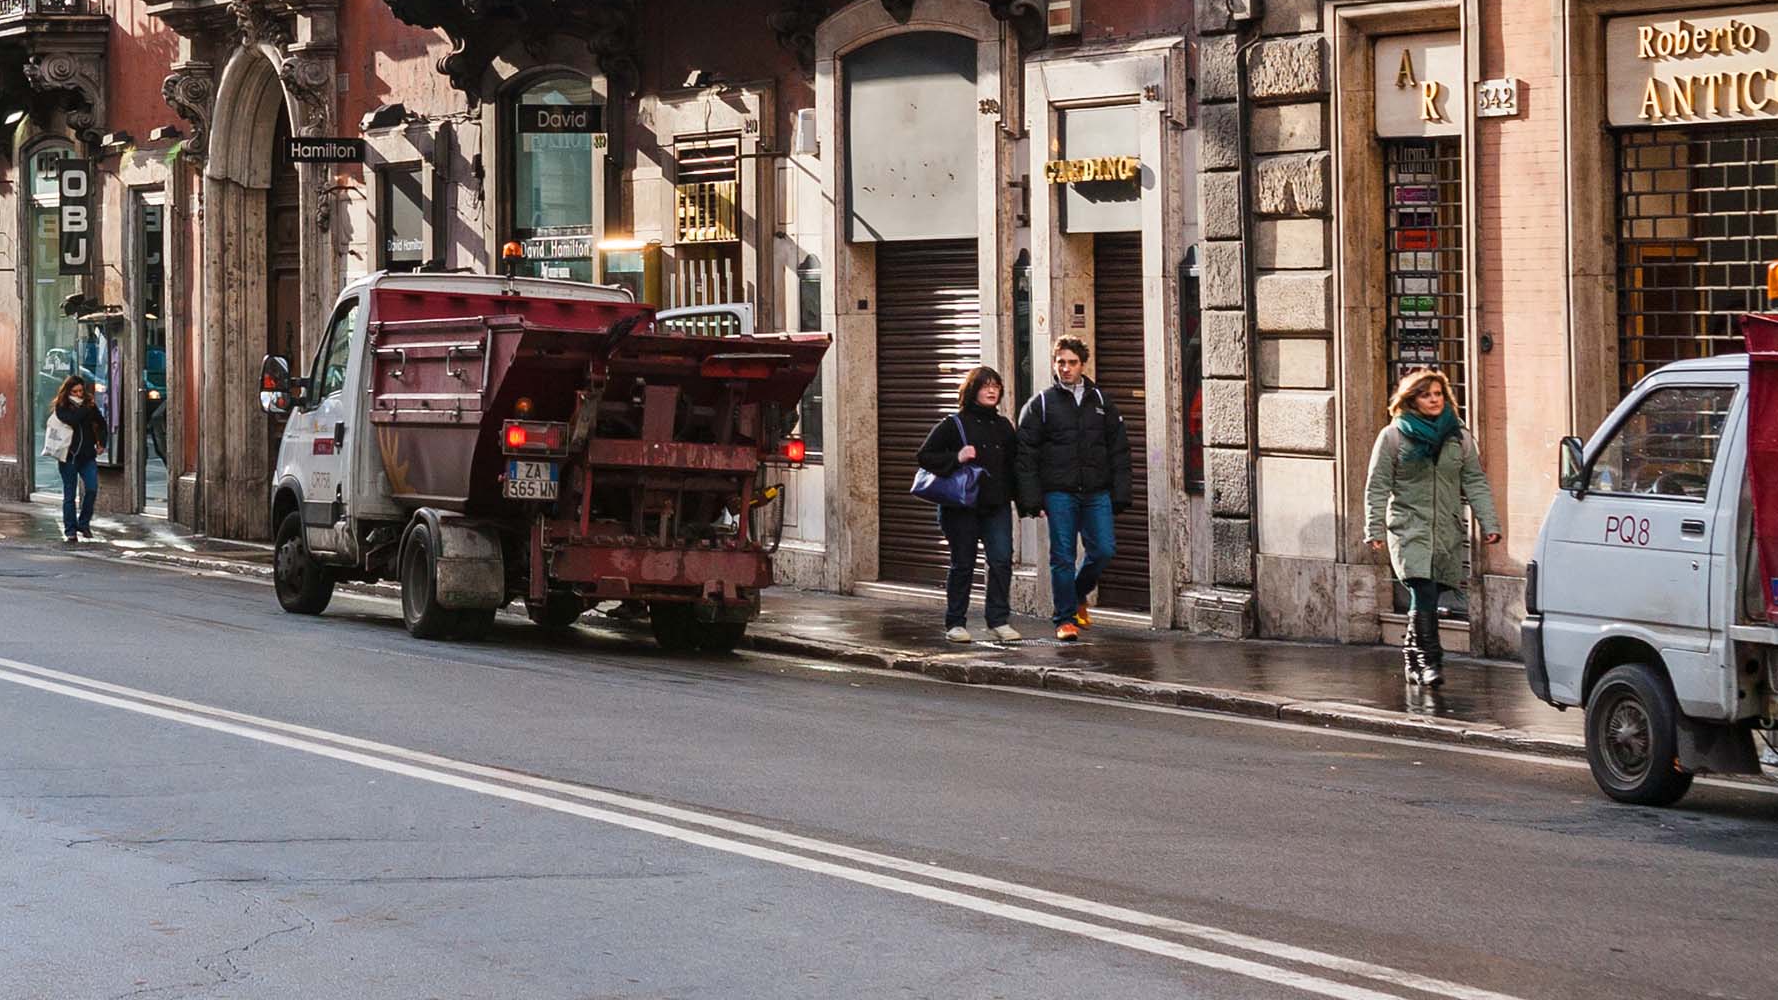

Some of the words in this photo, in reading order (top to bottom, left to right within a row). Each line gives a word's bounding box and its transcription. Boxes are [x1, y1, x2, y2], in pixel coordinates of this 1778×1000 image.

[1638, 19, 1756, 58] Roberto
[1395, 49, 1417, 90] A
[1420, 81, 1441, 120] R
[1478, 86, 1513, 110] 342
[1638, 68, 1778, 119] ANTIC
[537, 110, 587, 128] David
[291, 142, 356, 158] Hamilton
[1044, 156, 1130, 185] GARDINO
[61, 169, 88, 265] OBJ
[388, 239, 402, 251] David
[521, 241, 544, 258] David
[550, 240, 590, 257] Hamilton
[525, 463, 542, 479] ZA
[509, 481, 535, 497] 365
[540, 482, 558, 497] WN
[1605, 515, 1650, 546] PQ8
